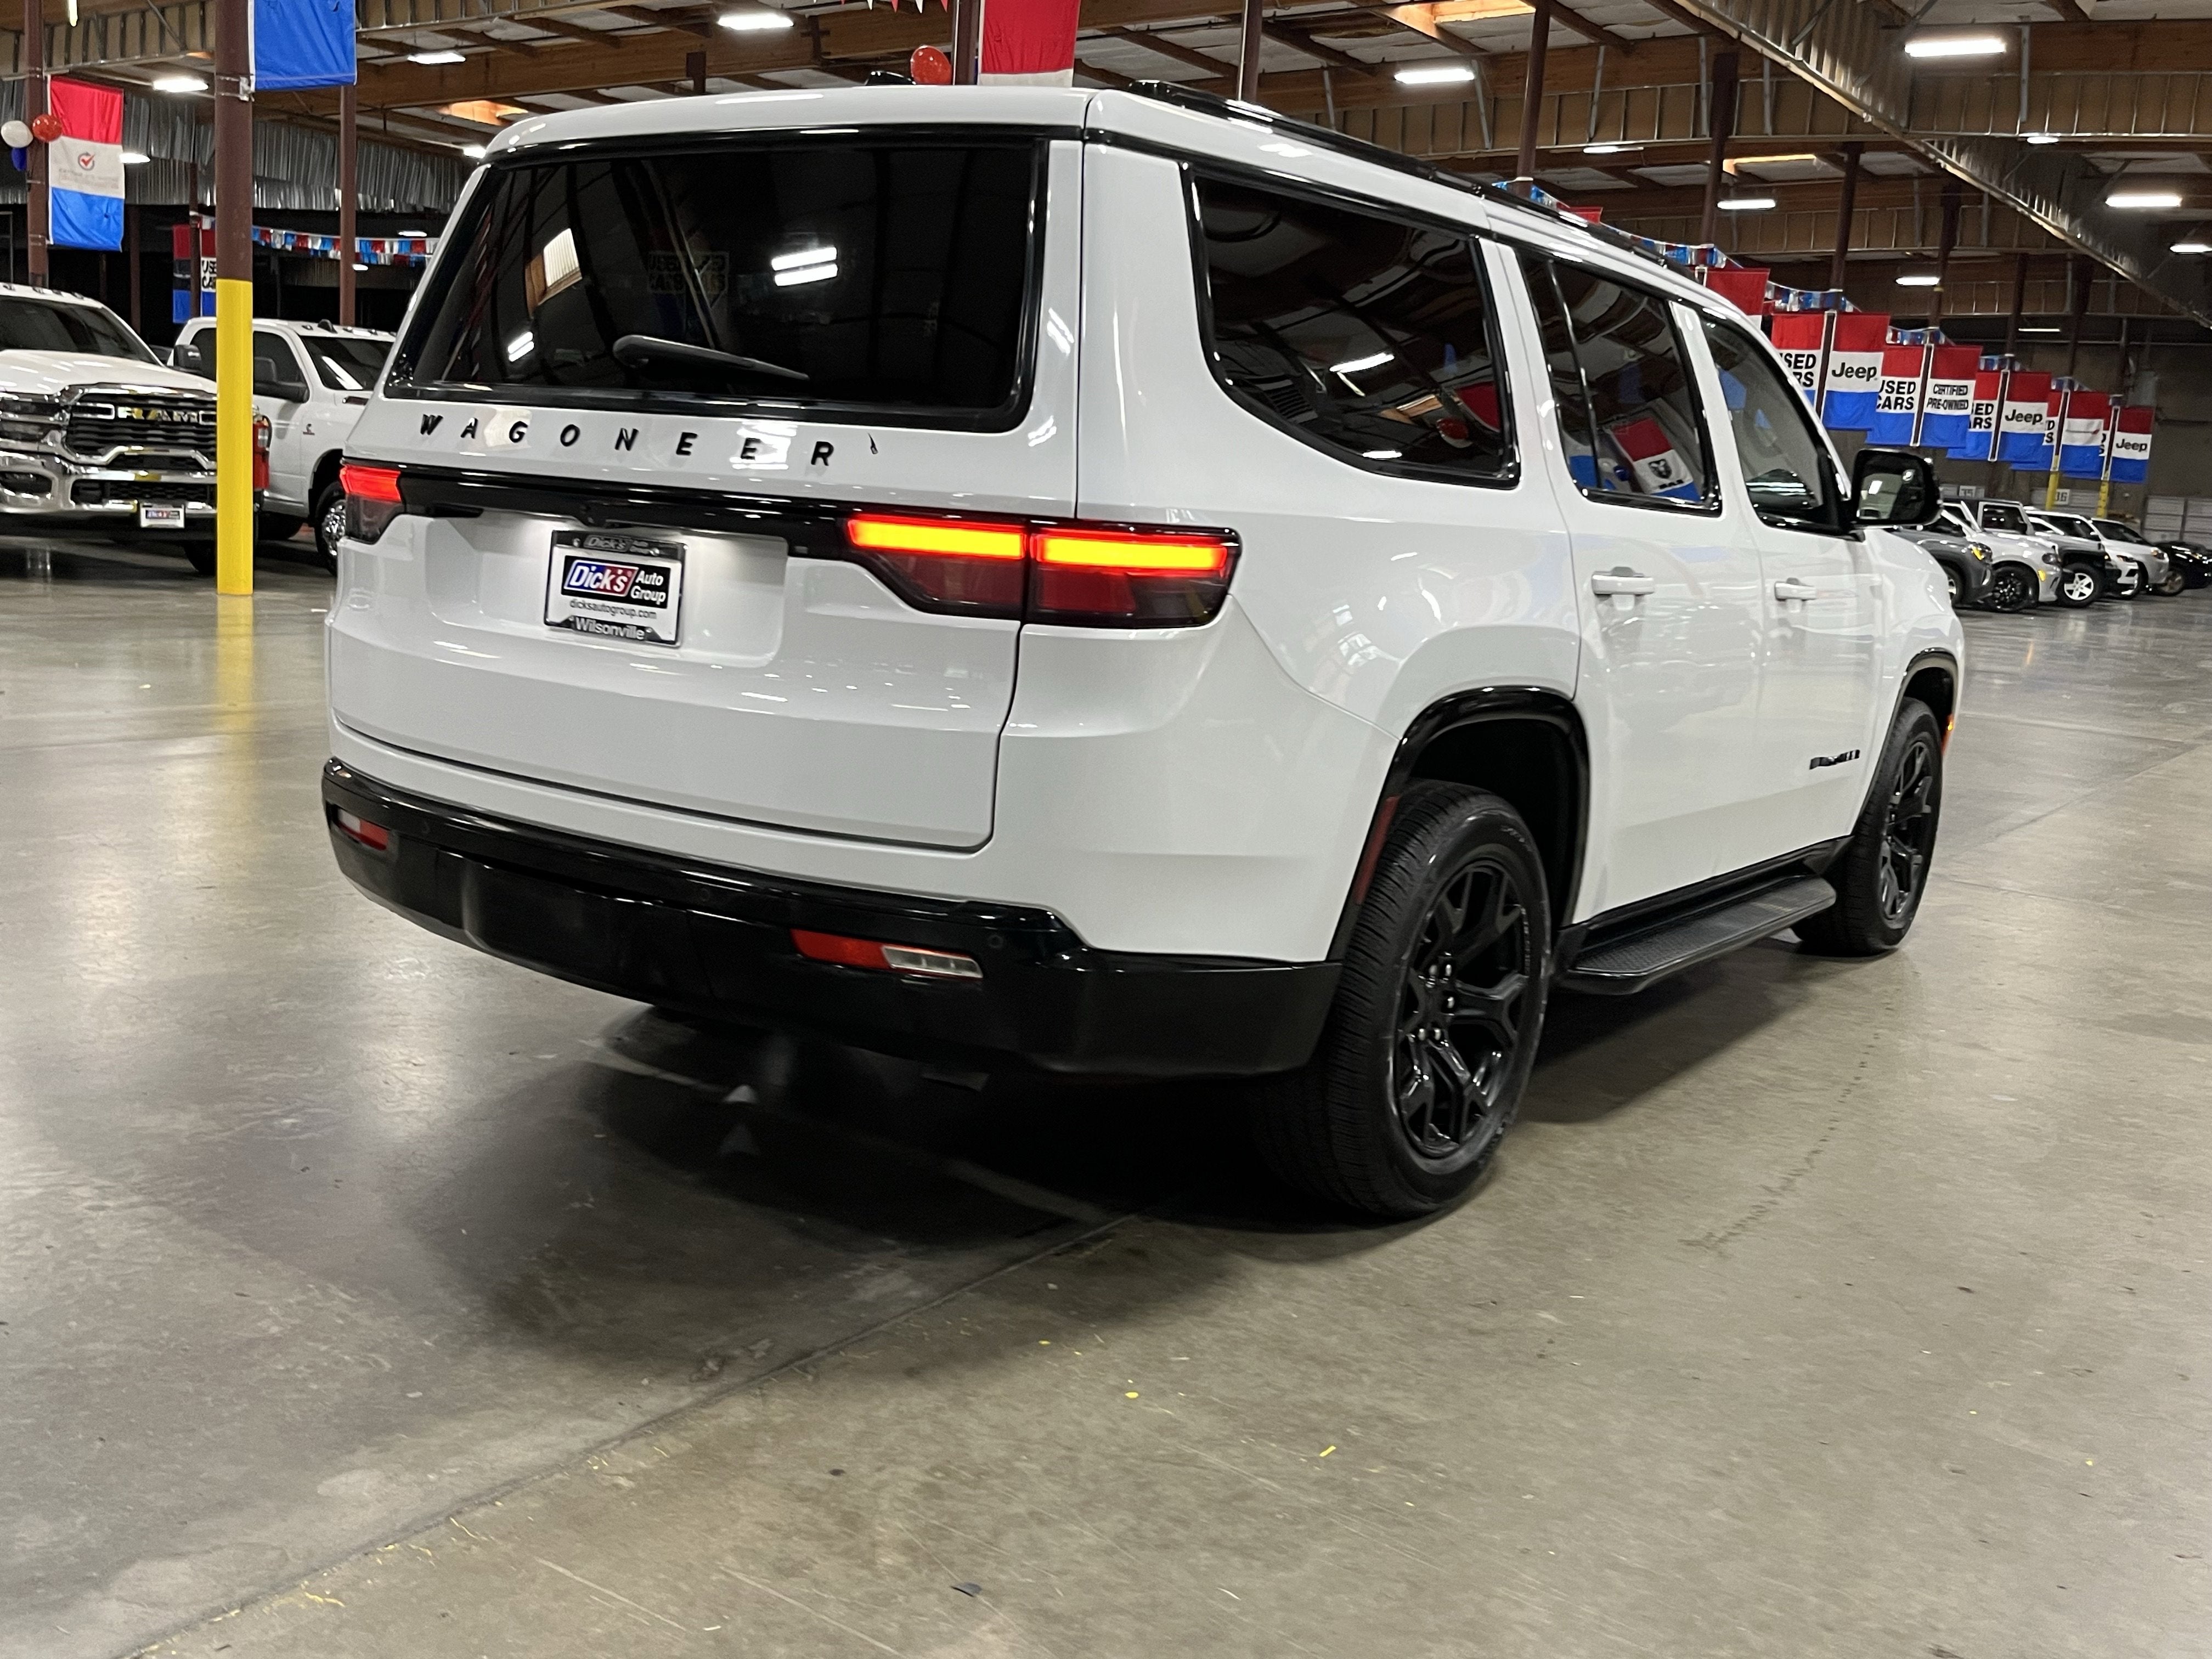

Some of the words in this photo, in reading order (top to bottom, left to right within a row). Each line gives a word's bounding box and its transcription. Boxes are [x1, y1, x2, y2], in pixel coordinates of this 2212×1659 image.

[1780, 353, 1816, 369] SED
[1792, 371, 1814, 387] RS
[1831, 362, 1877, 382] Jeep
[1933, 383, 1968, 396] CERTIFIED
[1926, 397, 1969, 410] PRE-OWNED
[1971, 403, 1994, 415] ED
[117, 406, 199, 423] RAM
[2005, 409, 2042, 425] Jeep
[1968, 417, 1992, 429] RS
[420, 414, 834, 467] WAGONEER
[2116, 438, 2148, 452] Jeep
[569, 565, 628, 592] Dick's
[635, 570, 664, 586] Auto
[630, 585, 666, 605] Group
[569, 599, 657, 619] dicksautogroup.com
[575, 617, 645, 640] Wilsonville
